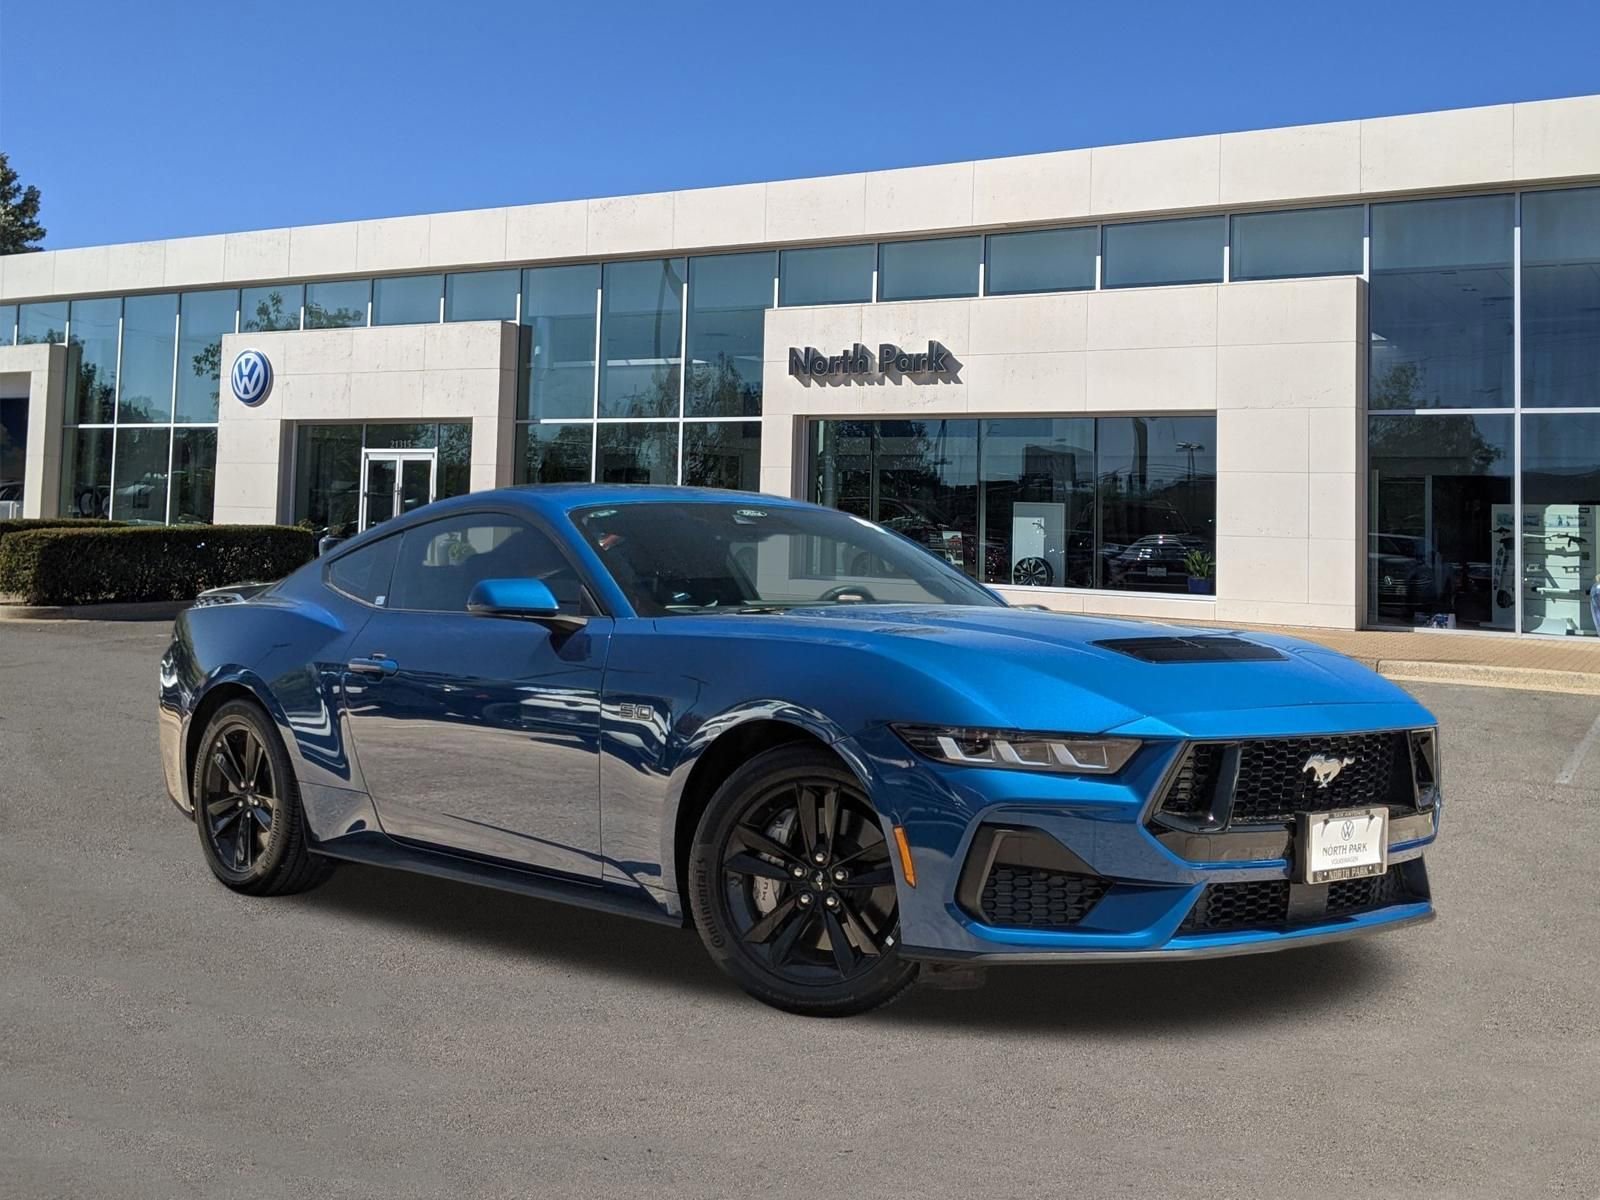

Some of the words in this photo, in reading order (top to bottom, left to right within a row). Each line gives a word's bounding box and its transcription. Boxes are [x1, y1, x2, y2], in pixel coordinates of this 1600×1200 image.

[788, 343, 873, 376] North
[878, 340, 948, 374] Park
[1322, 845, 1347, 856] NORTH
[1349, 843, 1367, 854] PARK
[696, 869, 724, 948] Continental
